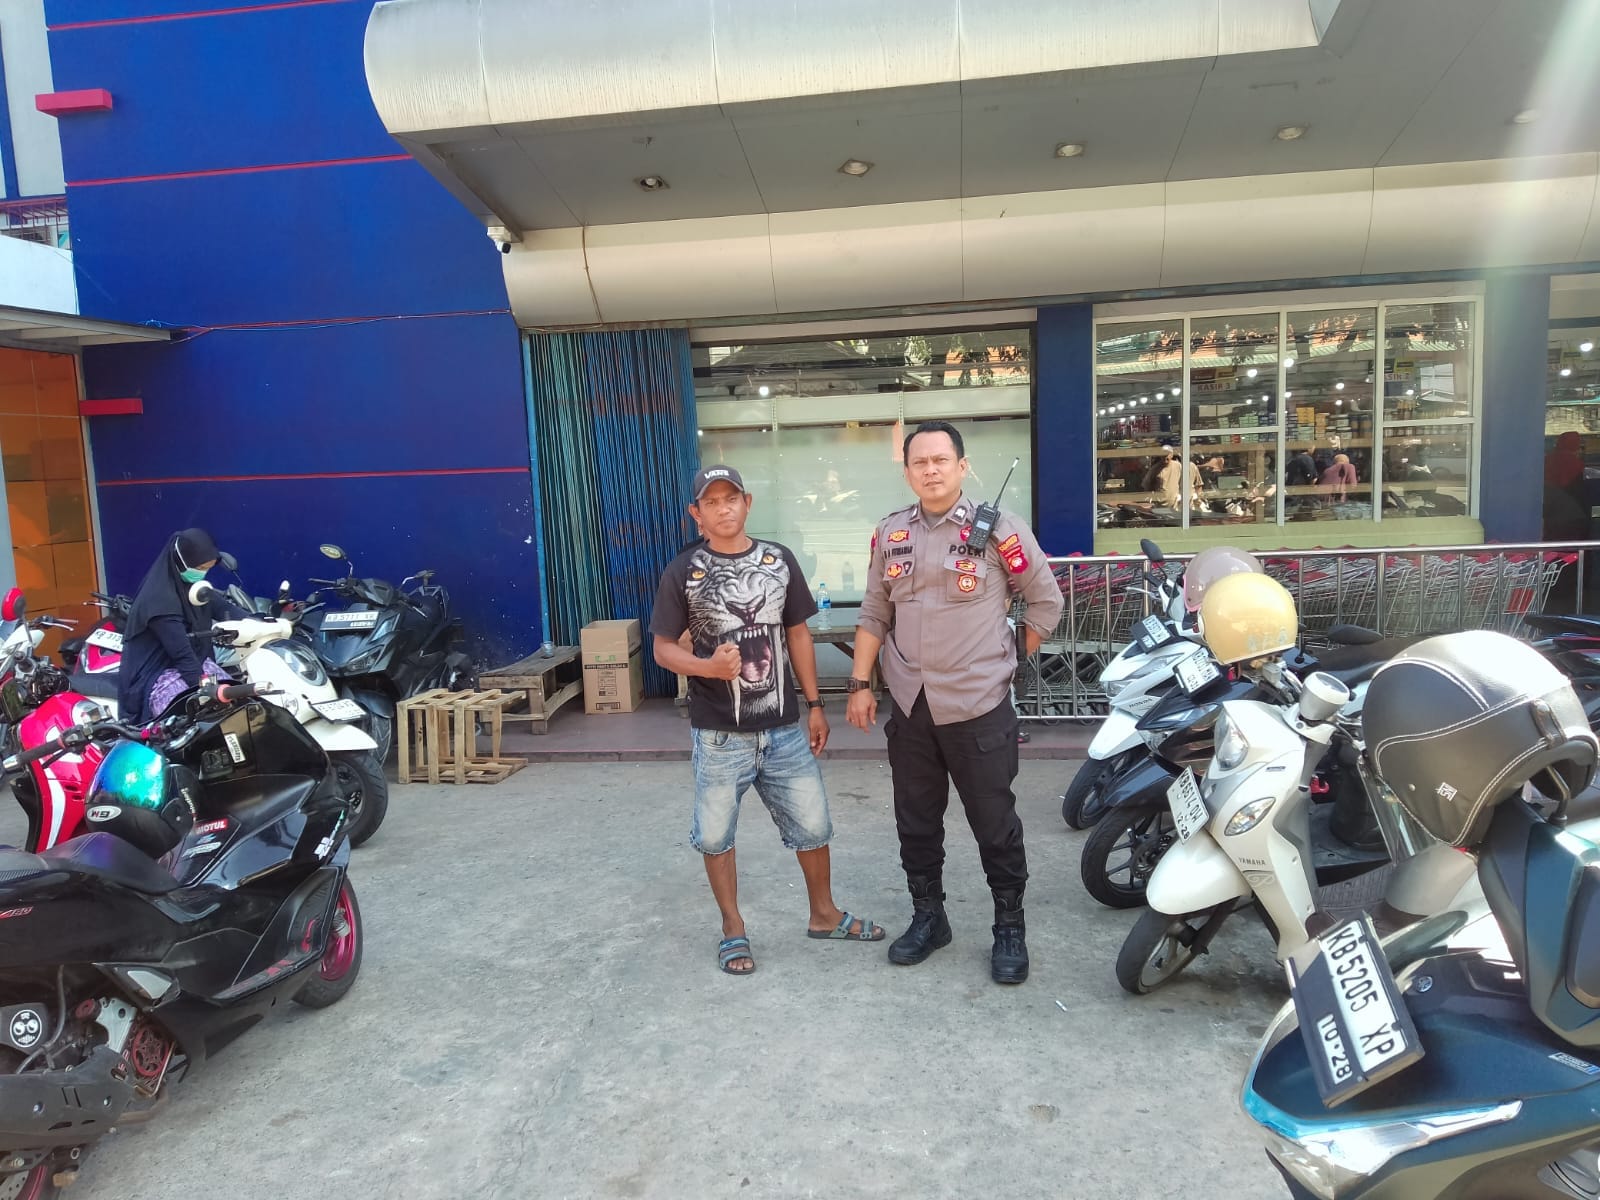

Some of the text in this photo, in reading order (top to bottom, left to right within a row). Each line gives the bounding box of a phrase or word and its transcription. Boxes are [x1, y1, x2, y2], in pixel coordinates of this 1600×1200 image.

[1197, 383, 1223, 392] KASIR
[704, 469, 730, 479] VANS
[196, 820, 226, 834] MOTUL
[1238, 857, 1266, 866] YAMAHA
